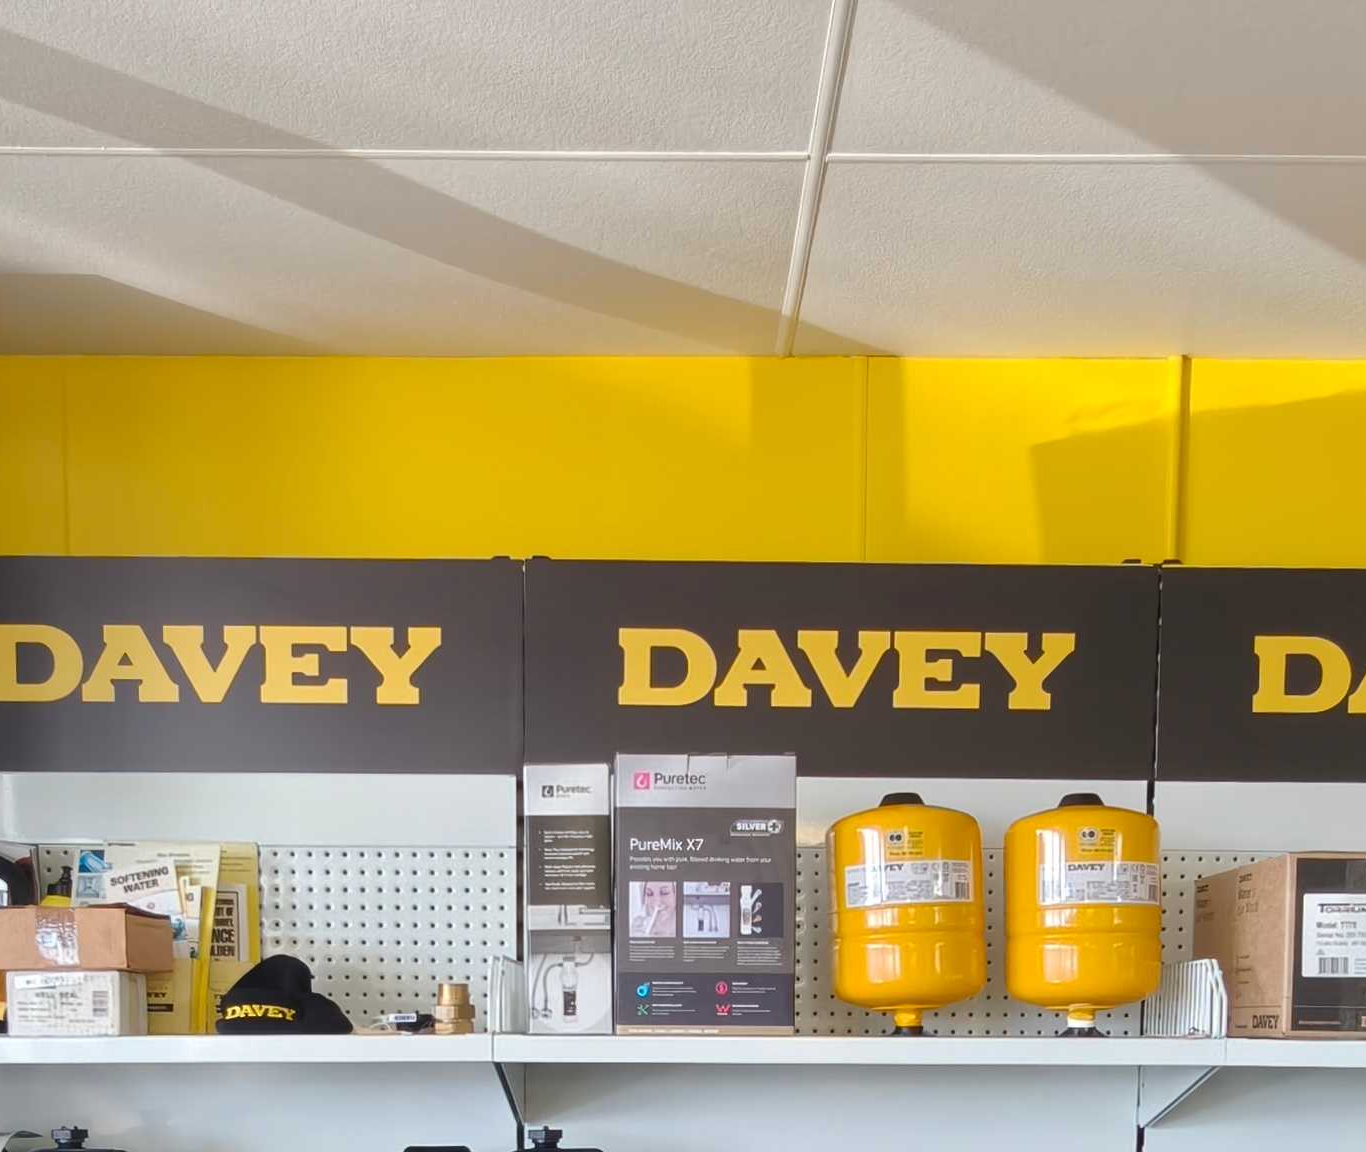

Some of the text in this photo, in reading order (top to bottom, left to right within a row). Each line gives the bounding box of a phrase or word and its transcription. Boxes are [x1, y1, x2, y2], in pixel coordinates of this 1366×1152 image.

[617, 628, 1077, 710] DAVEY
[654, 773, 707, 786] Puretec
[556, 785, 591, 795] Puretec
[736, 823, 766, 831] SILVER
[629, 838, 704, 851] PureMix X7
[1068, 864, 1105, 872] DAVEY
[110, 866, 169, 886] SOFTENING
[123, 879, 159, 893] WATER
[225, 1004, 297, 1023] DAVEY
[1252, 1015, 1279, 1029] DAVEY
